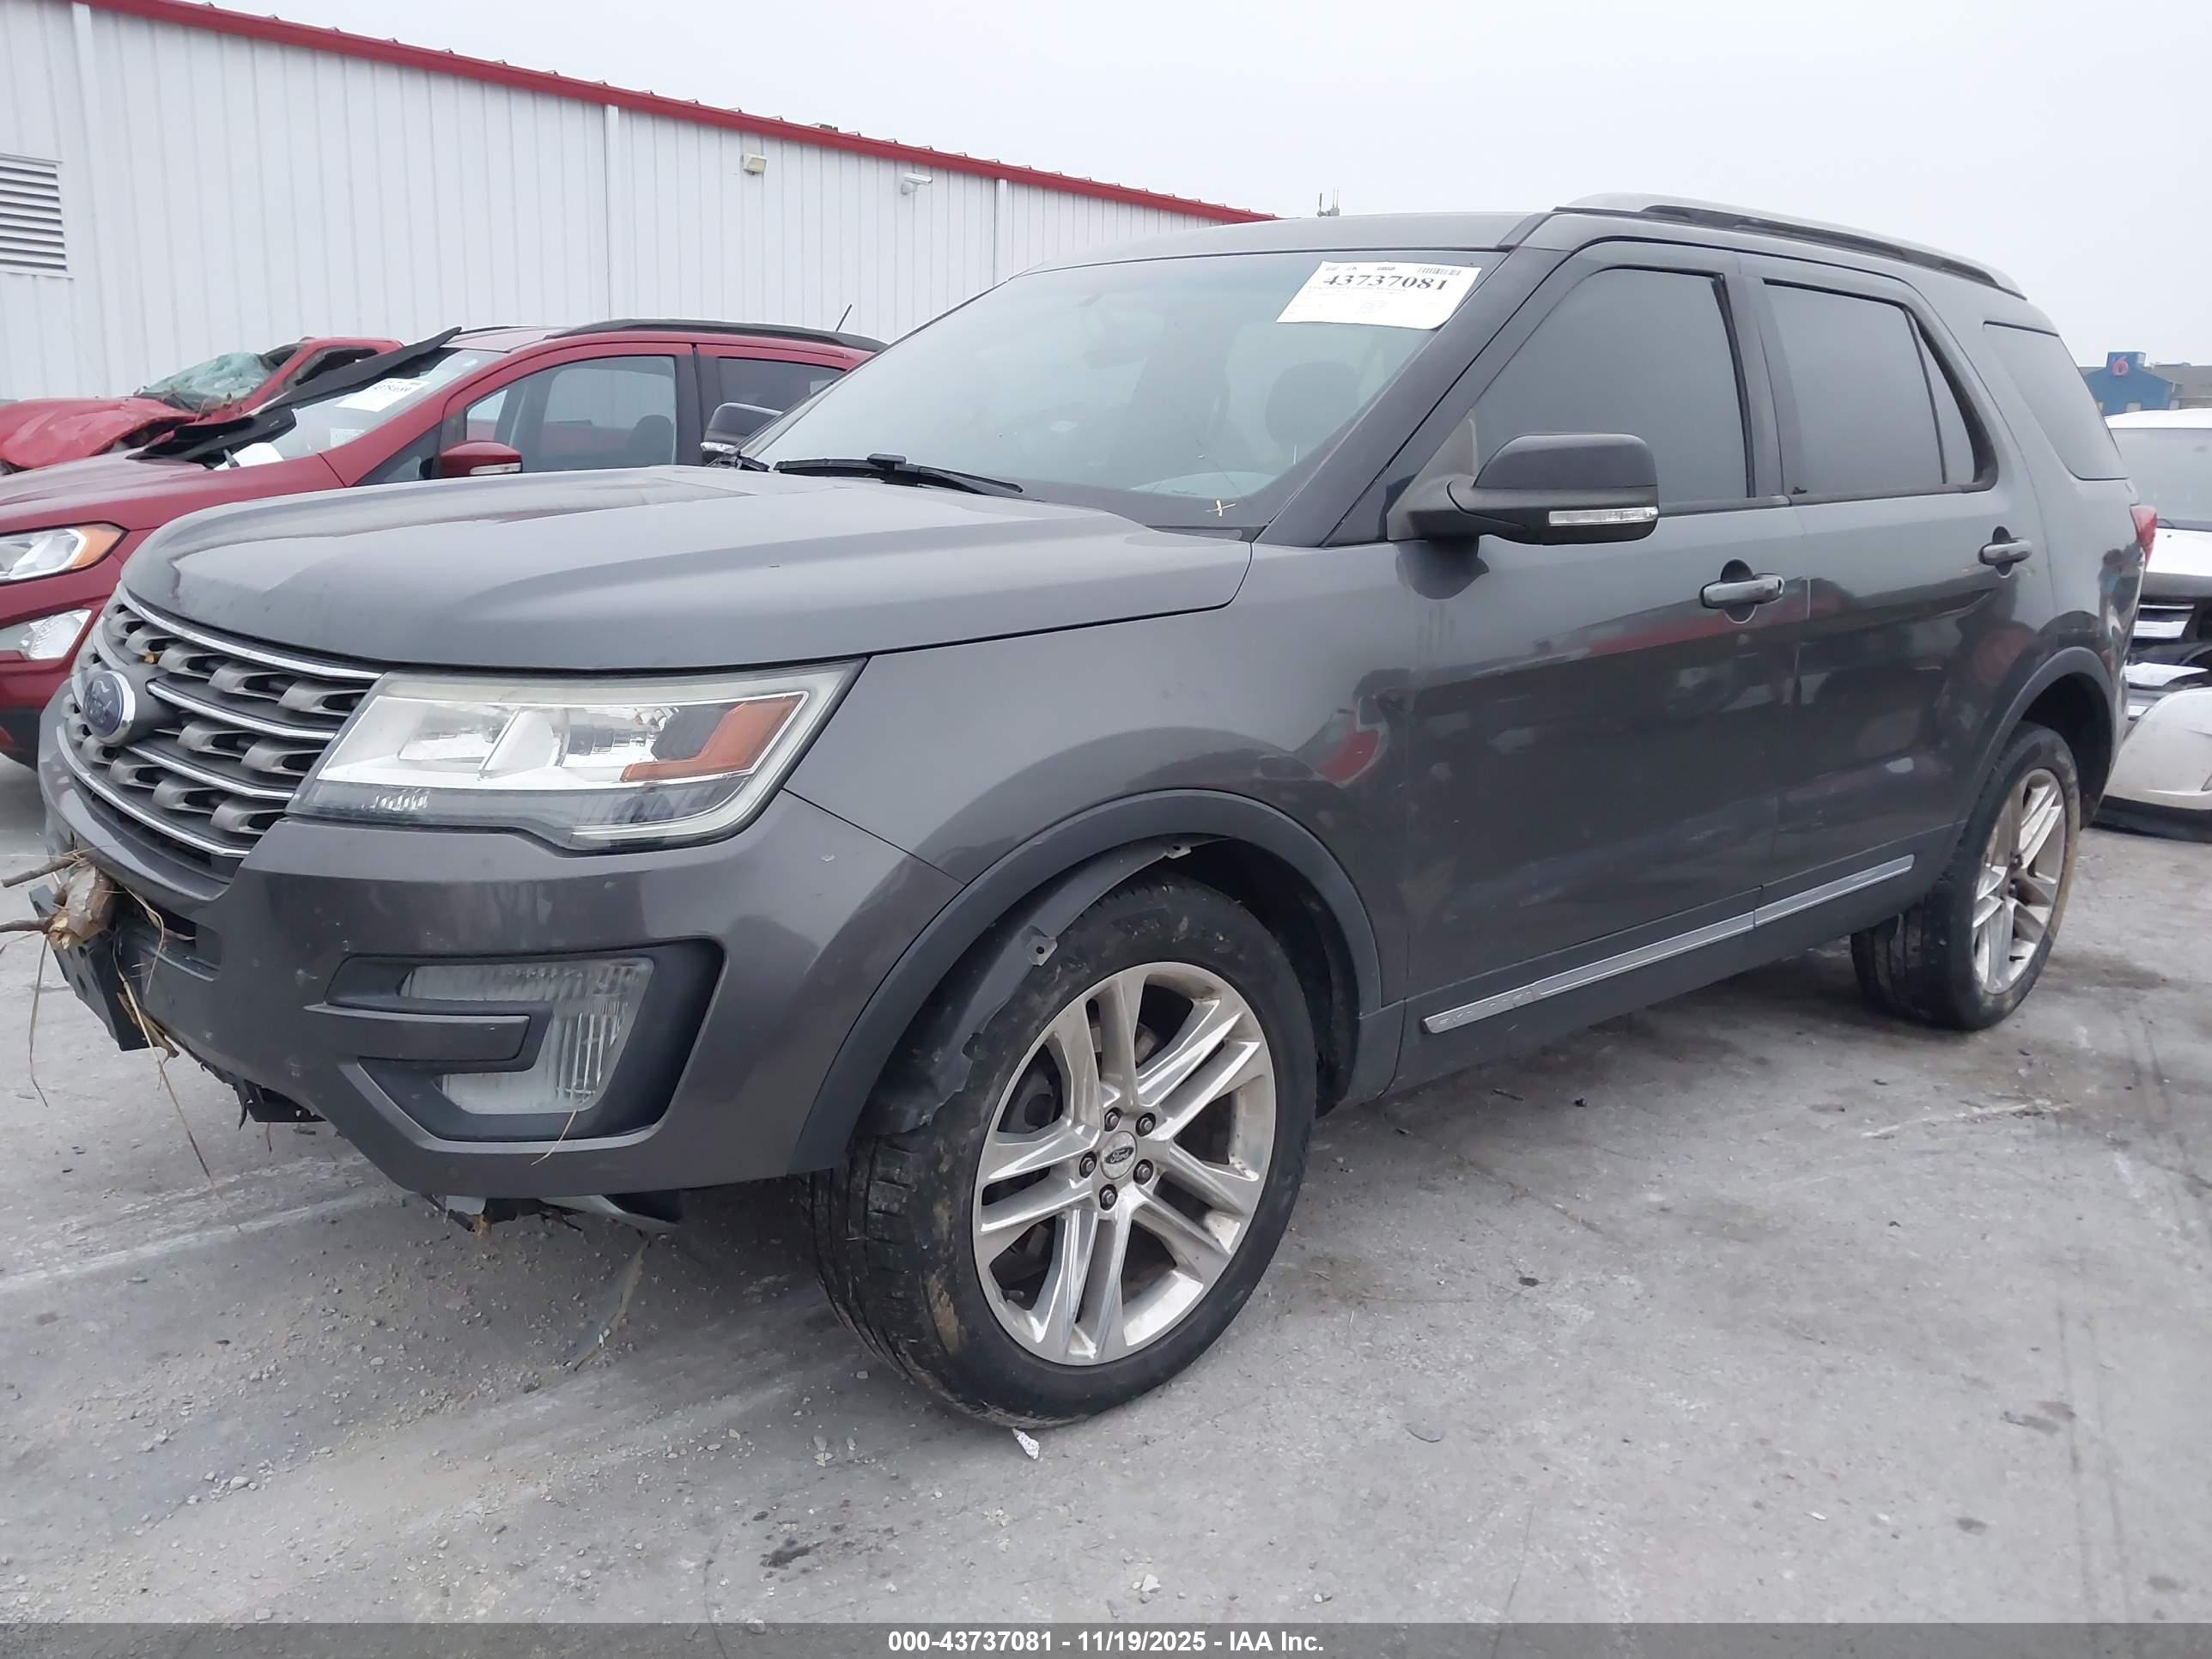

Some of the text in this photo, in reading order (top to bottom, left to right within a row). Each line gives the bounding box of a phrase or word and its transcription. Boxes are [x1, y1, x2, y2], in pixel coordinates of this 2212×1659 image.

[1323, 274, 1448, 290] 43737081
[2112, 356, 2130, 376] 6
[1109, 1148, 1130, 1164] Ford
